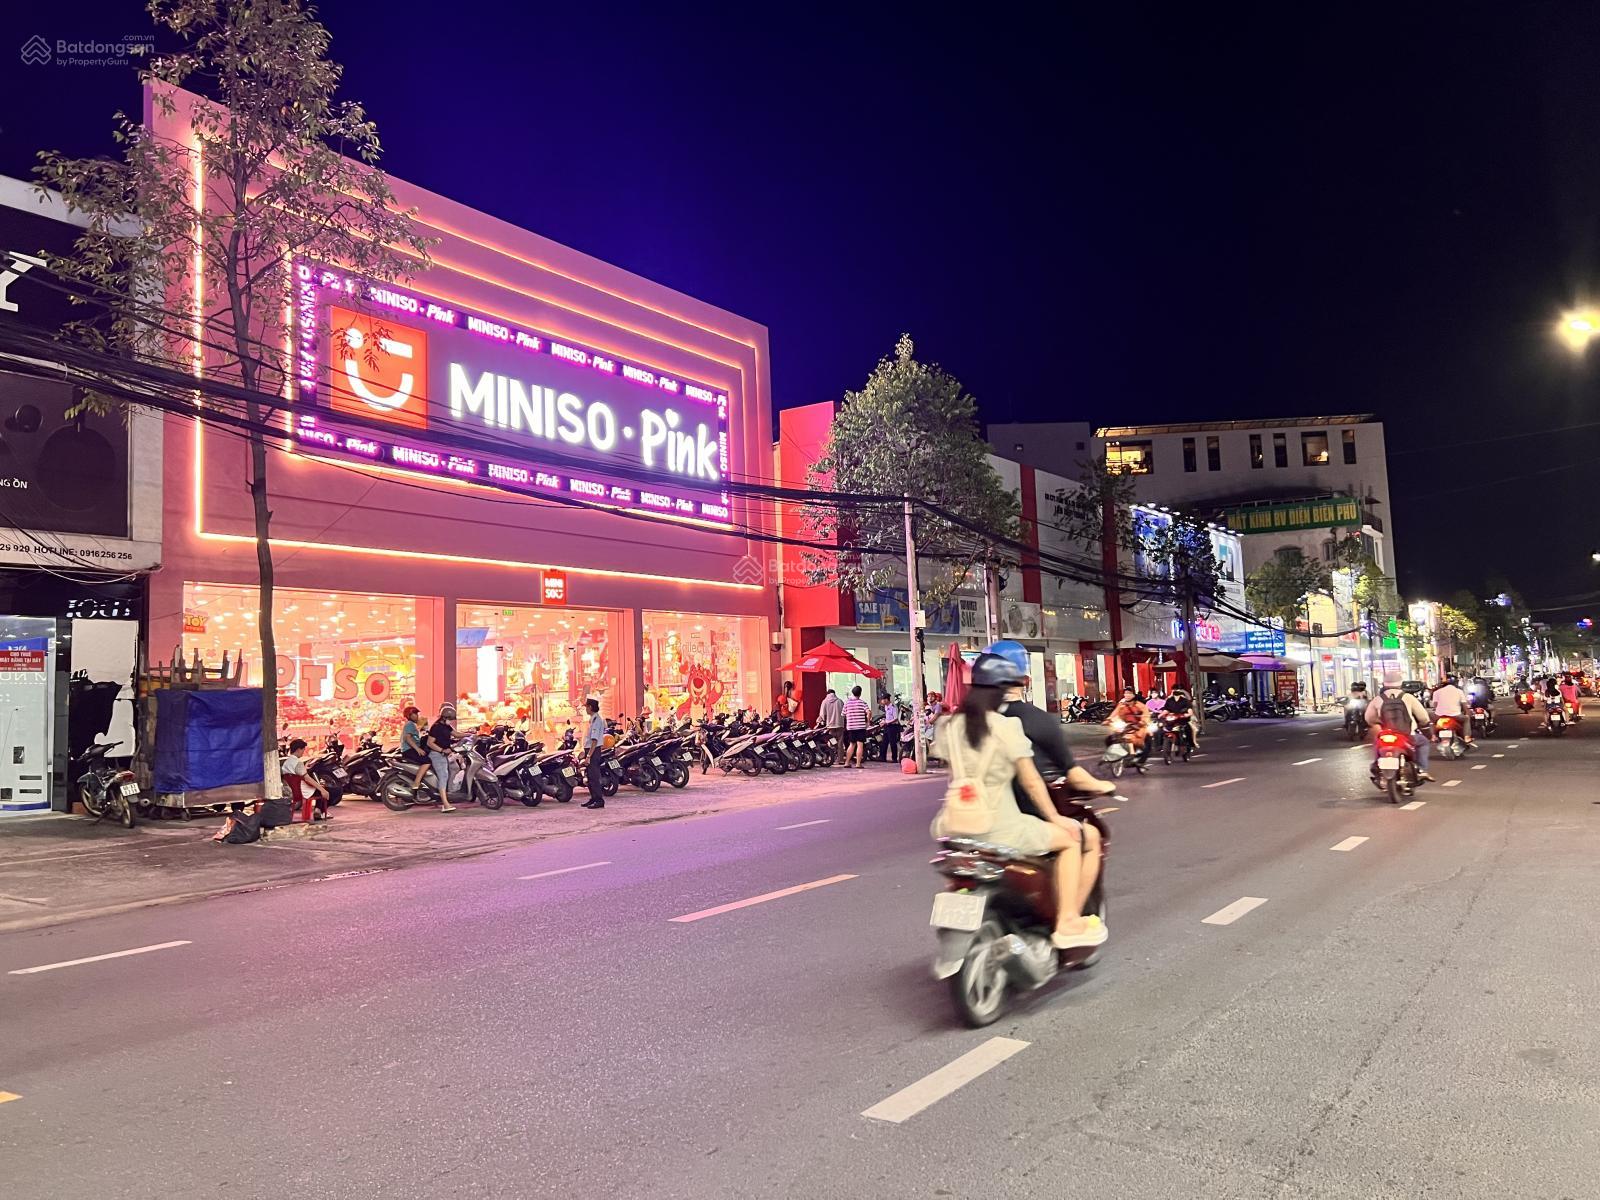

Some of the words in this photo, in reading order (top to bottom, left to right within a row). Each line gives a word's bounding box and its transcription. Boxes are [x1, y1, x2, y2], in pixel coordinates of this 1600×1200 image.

[426, 304, 455, 324] Pink
[468, 316, 509, 340] MINISO
[516, 331, 541, 350] Pink
[551, 342, 586, 364] MINISO
[592, 355, 615, 373] Pink
[623, 365, 654, 385] MINISO
[659, 376, 678, 393] Pink
[686, 385, 713, 403] MINISO
[449, 361, 615, 451] MINISO
[641, 407, 719, 481] Pink
[718, 431, 728, 470] MINISO
[393, 446, 439, 467] MINISO
[488, 463, 528, 482] MINISO
[536, 472, 560, 488] Pink
[570, 478, 604, 497] MINISO
[640, 491, 671, 508] MINISO
[676, 498, 695, 512] Pink
[702, 503, 728, 518] MINISO
[184, 615, 209, 627] TOY
